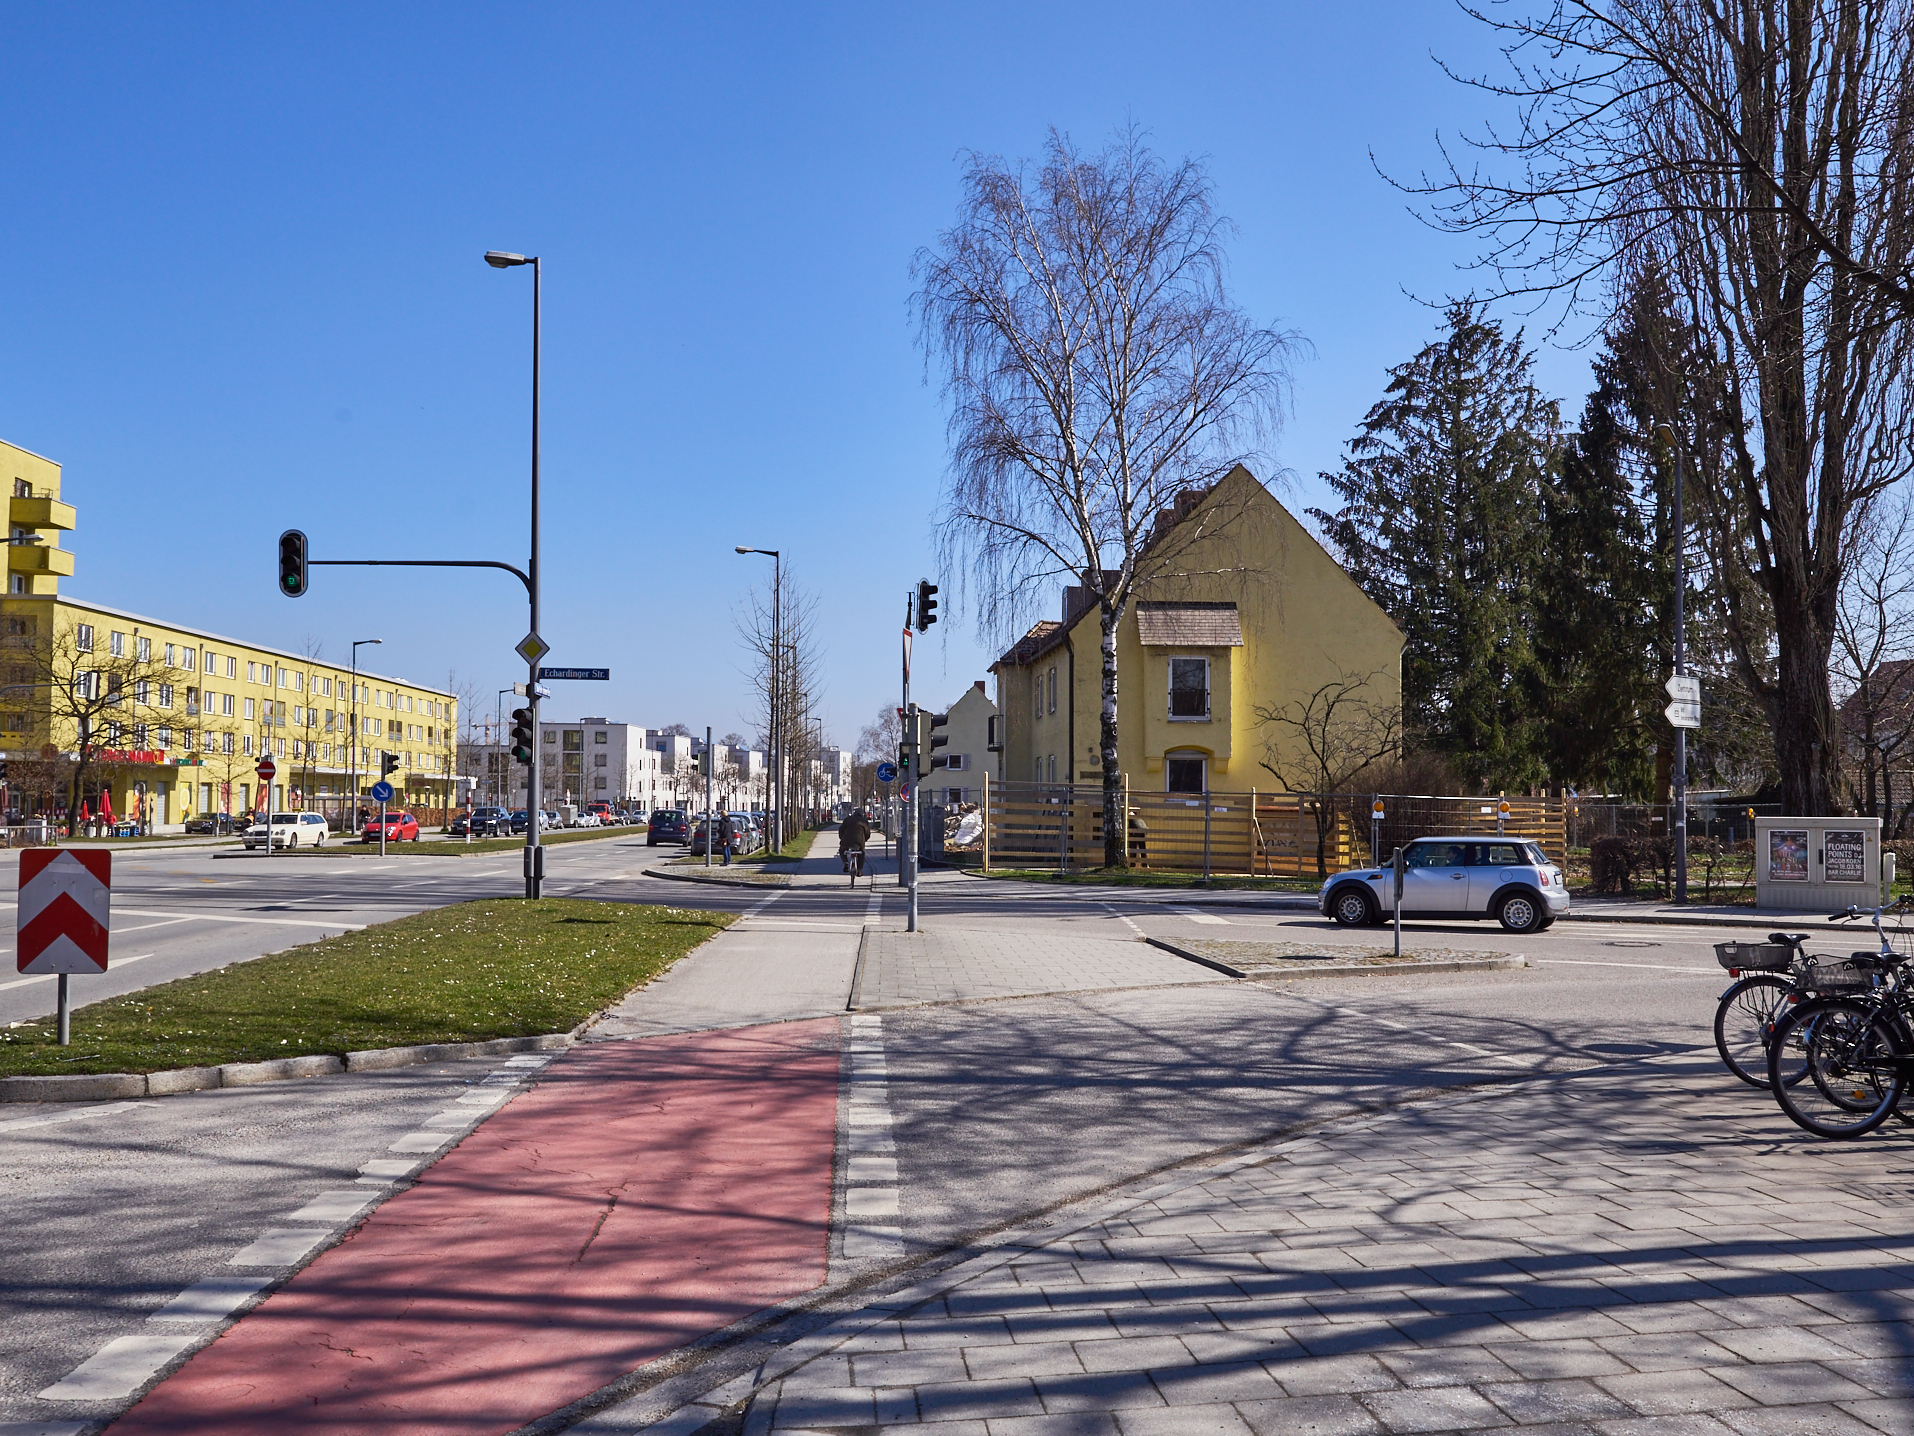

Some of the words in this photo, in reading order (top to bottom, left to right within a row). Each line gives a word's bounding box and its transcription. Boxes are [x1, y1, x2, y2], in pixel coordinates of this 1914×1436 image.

[544, 669, 589, 679] Echardinger
[592, 670, 605, 678] Str.
[1828, 843, 1861, 851] FLOATING
